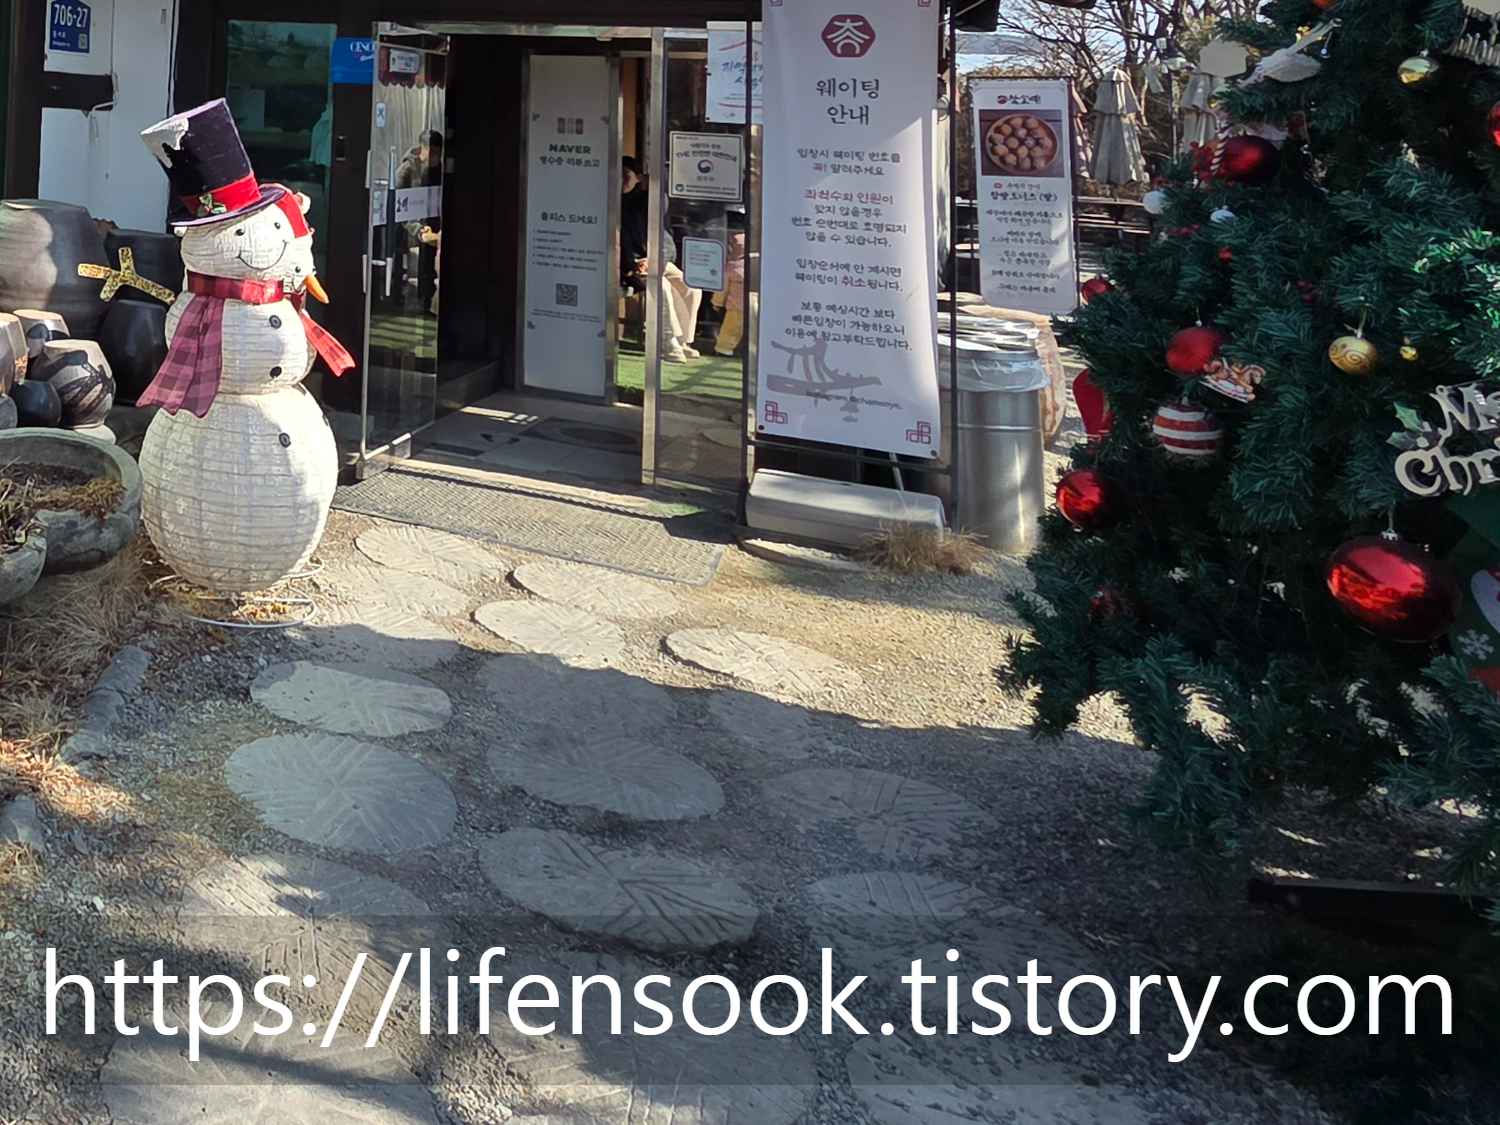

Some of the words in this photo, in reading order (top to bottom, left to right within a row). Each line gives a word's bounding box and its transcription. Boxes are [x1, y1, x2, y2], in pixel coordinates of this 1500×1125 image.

[54, 4, 88, 28] 706-27
[815, 77, 879, 99] 웨이팅
[827, 104, 869, 126] 안내
[549, 143, 592, 154] NAVER
[797, 148, 829, 159] 입장시
[833, 150, 865, 161] 웨이팅
[868, 152, 901, 163] 번호를
[813, 163, 827, 173] 꼭!
[830, 163, 885, 176] 알려주세요
[804, 189, 853, 202] 좌석수와
[857, 192, 893, 205] 인원이
[568, 214, 598, 225] 드세요!
[815, 204, 836, 215] 맞지
[839, 205, 883, 218] 않을경우
[791, 216, 812, 227] 번호
[815, 218, 859, 230] 순번대로
[862, 221, 907, 233] 호명되지
[805, 231, 826, 242] 않을
[830, 233, 841, 243] 수
[844, 235, 892, 247] 있습니다.
[796, 258, 851, 272] 입장순서에
[853, 264, 865, 274] 안
[867, 265, 902, 277] 계시면
[795, 272, 838, 285] 웨이팅이
[841, 275, 903, 292] 취소됩니다.
[801, 301, 822, 312] 보통
[825, 304, 870, 317] 예상시간
[873, 309, 896, 319] 보다
[792, 314, 846, 329] 빠른입장이
[850, 320, 905, 335] 가능하오니
[785, 327, 818, 339] 이용에
[821, 330, 913, 351] 참고부탁드립니다.
